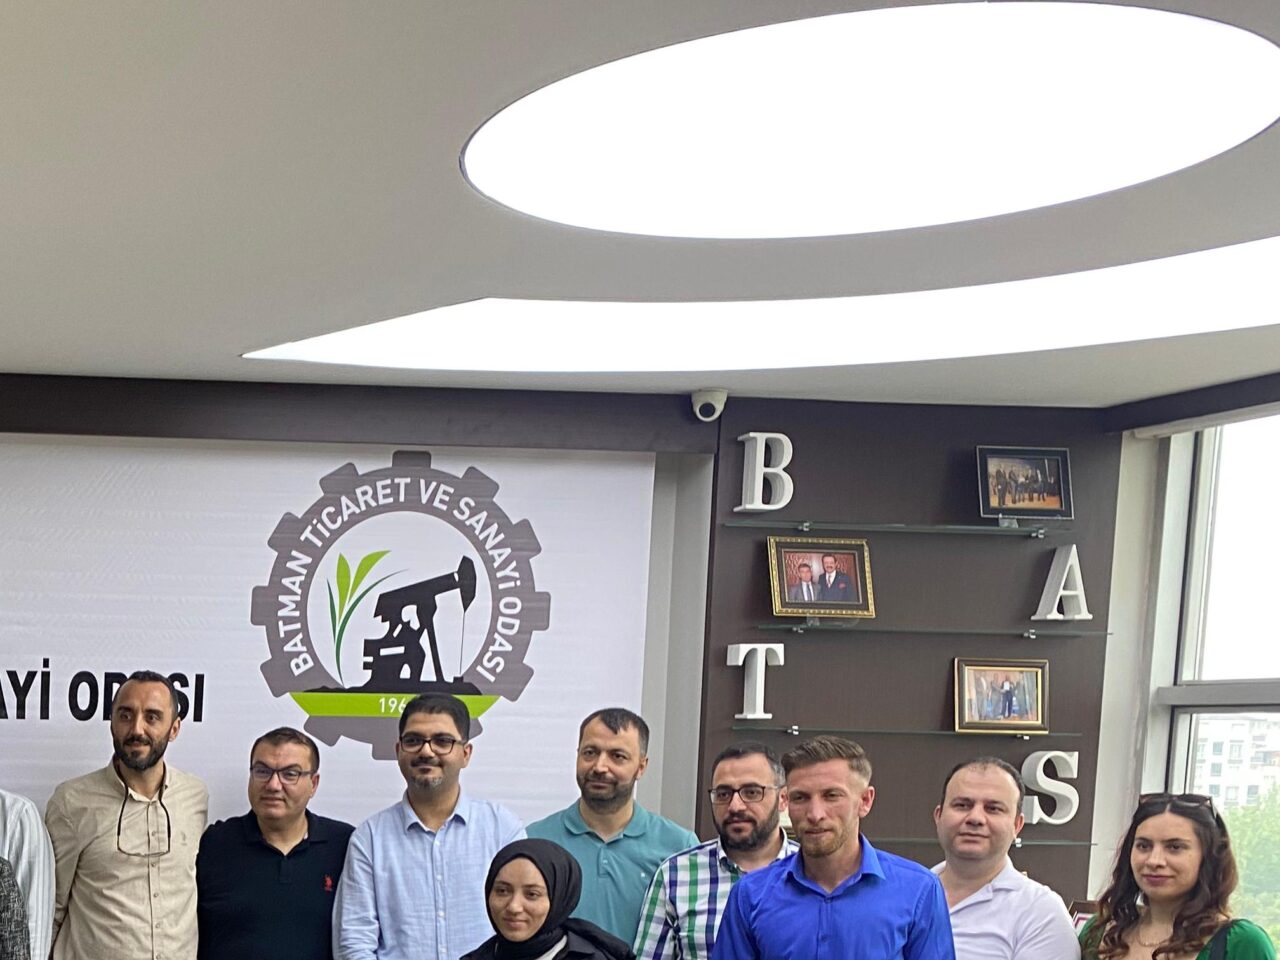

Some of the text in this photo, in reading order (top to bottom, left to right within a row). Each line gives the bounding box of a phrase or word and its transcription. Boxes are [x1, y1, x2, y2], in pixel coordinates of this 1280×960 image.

[276, 477, 522, 683] BATMAN TİCARET VE SANAYİ ODASI
